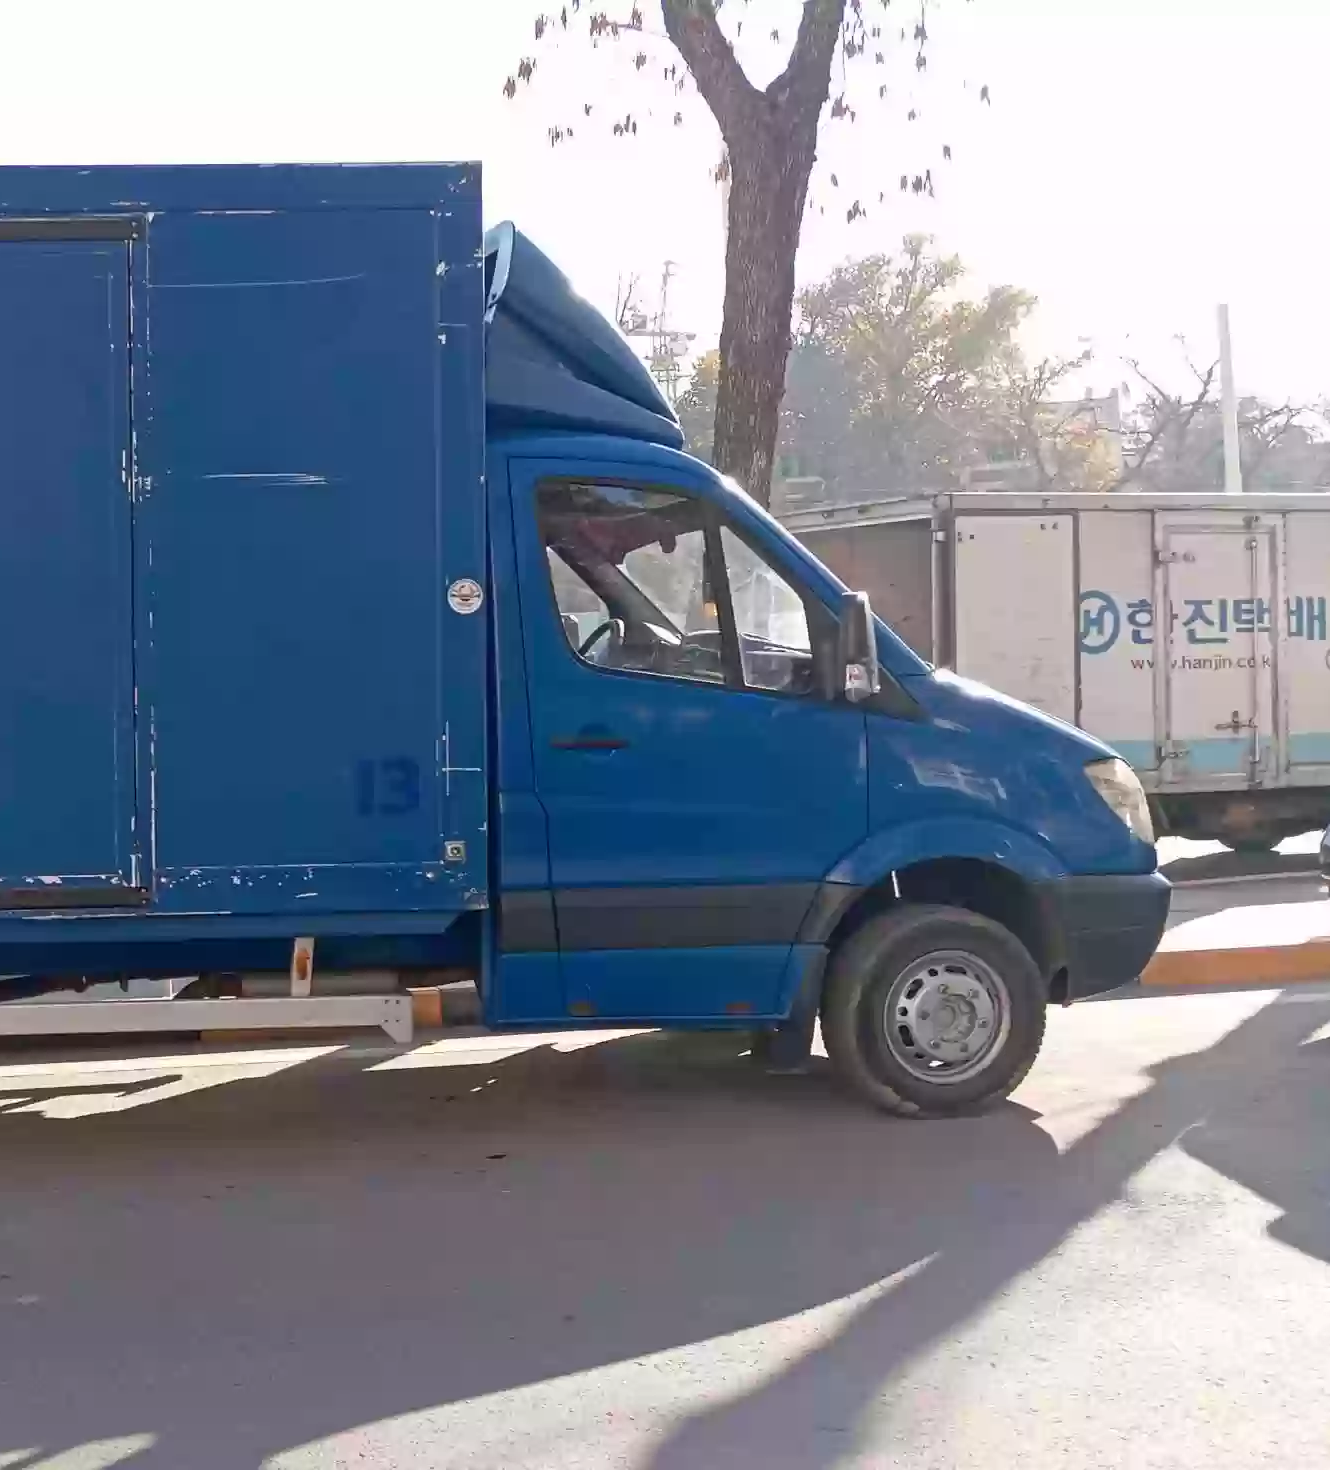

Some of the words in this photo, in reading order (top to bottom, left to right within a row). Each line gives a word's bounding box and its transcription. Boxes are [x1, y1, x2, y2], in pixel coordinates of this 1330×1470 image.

[1126, 596, 1327, 645] 한진택배
[1131, 655, 1271, 671] ww.hanjin.cok
[357, 757, 420, 817] 13
